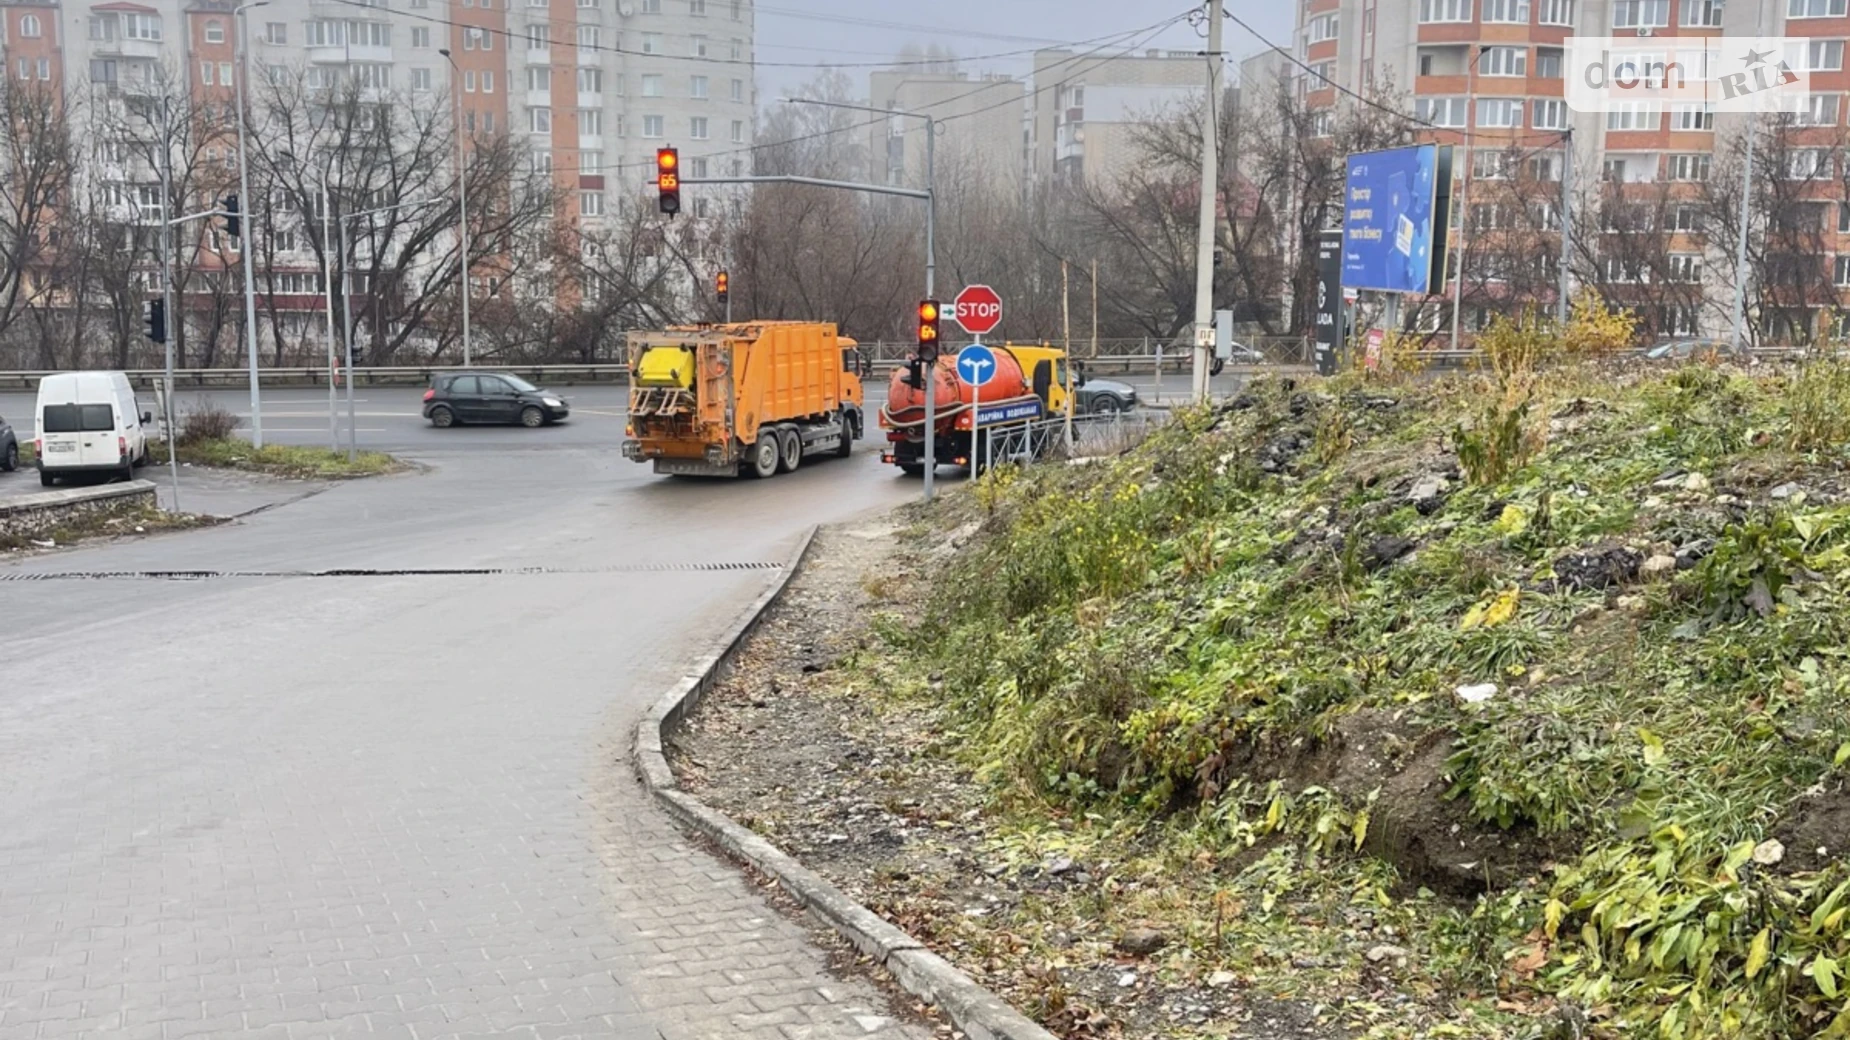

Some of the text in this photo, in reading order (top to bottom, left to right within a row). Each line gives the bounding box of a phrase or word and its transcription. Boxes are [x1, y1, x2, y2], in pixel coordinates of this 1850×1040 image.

[660, 174, 677, 187] 65
[957, 302, 1000, 318] STOP
[921, 325, 936, 339] 64
